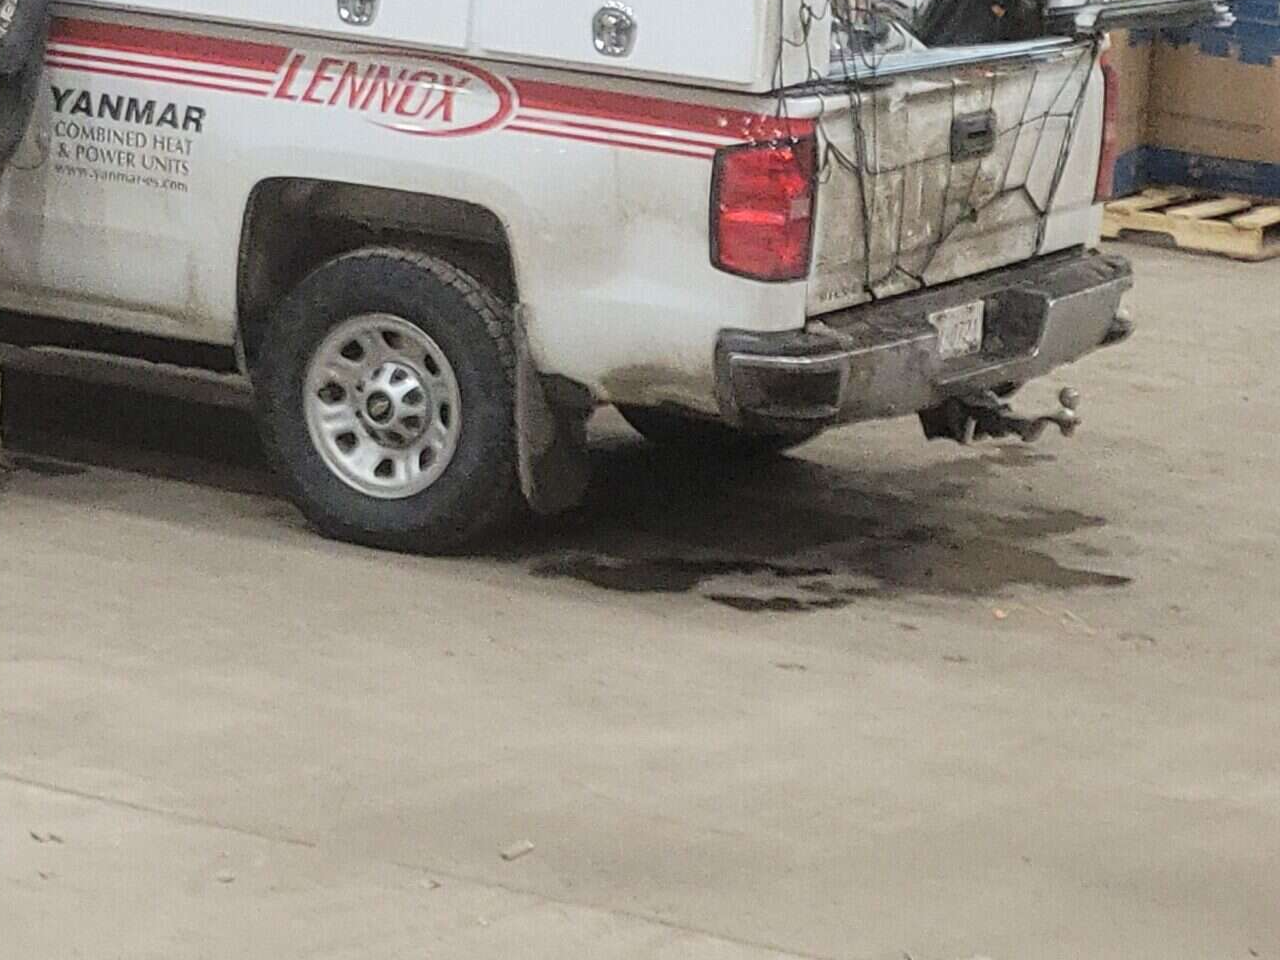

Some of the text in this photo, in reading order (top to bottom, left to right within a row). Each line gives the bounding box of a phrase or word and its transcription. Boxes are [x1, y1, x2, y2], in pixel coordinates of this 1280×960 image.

[50, 85, 207, 133] YANMAR
[274, 52, 472, 123] LENNOX
[55, 119, 193, 157] COMBINED HEAT
[57, 142, 190, 177] & POWER UNITS
